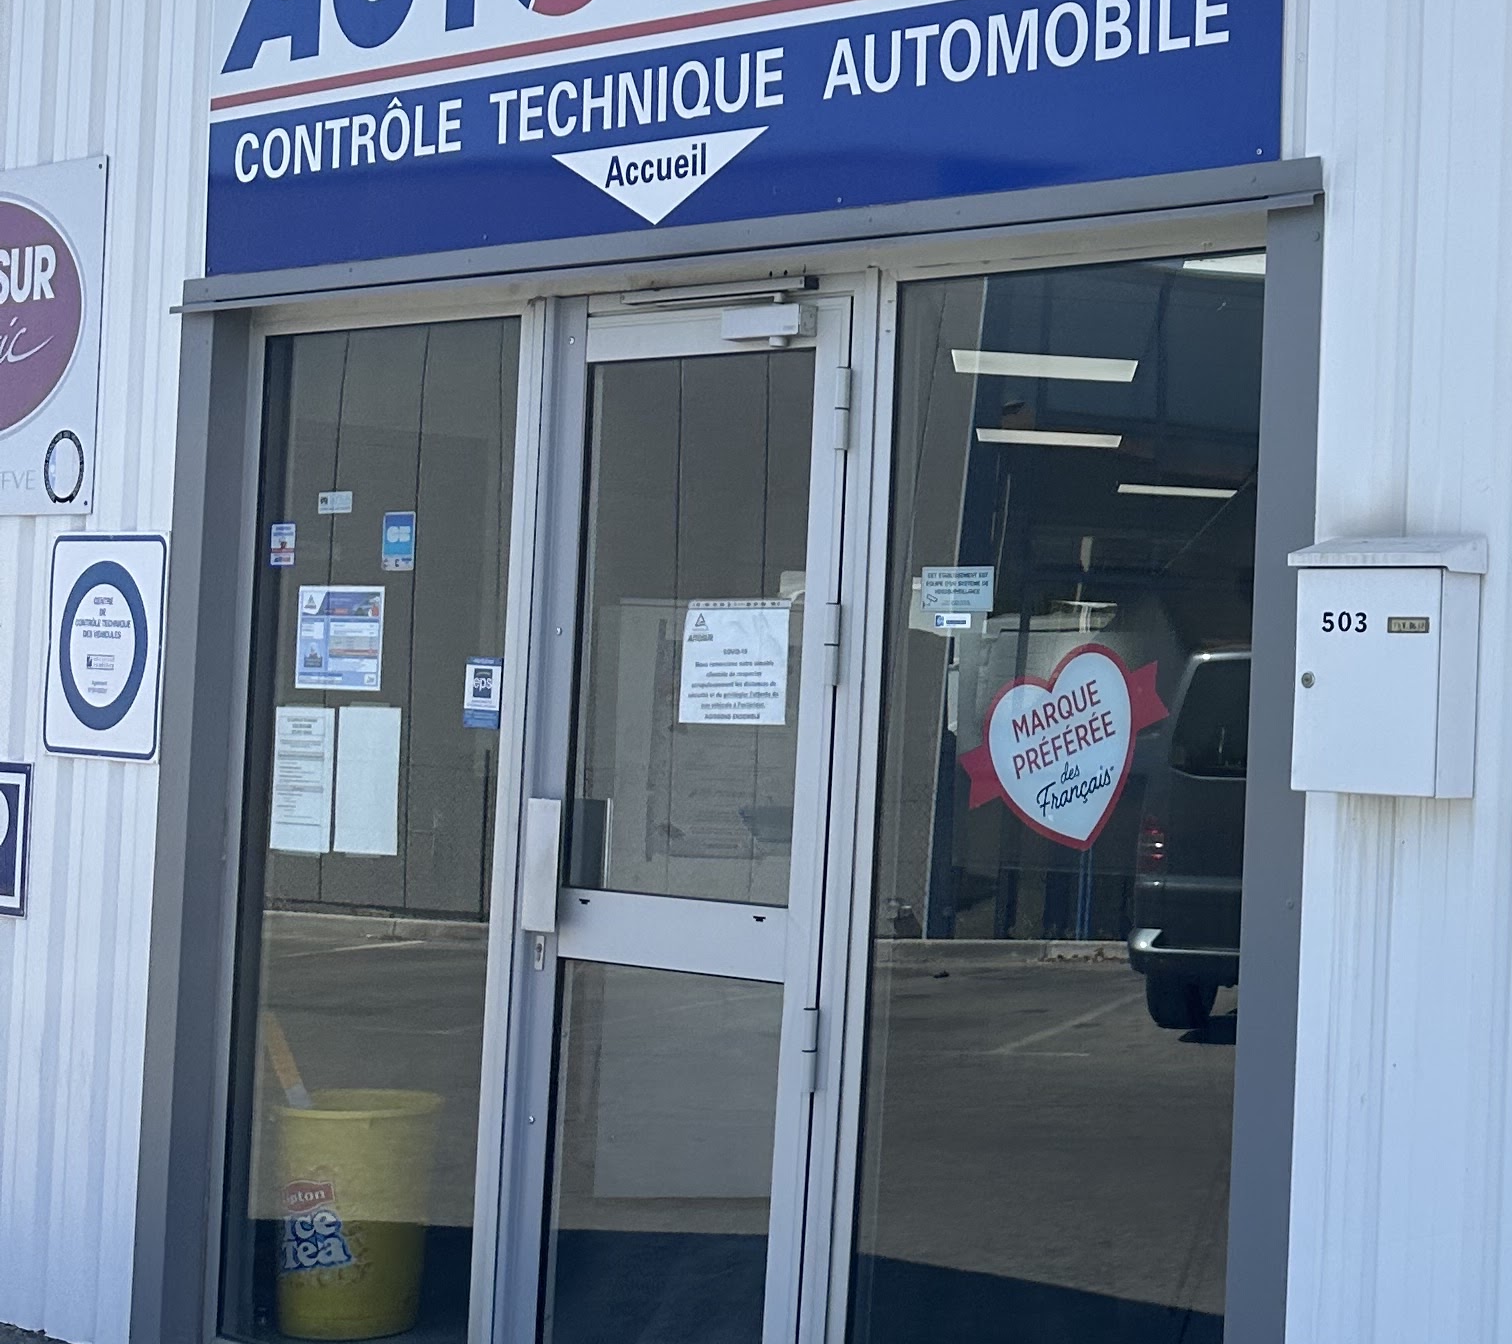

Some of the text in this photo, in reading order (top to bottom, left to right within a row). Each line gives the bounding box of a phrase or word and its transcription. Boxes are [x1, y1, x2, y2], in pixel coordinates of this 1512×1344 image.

[234, 97, 463, 183] CONTRÔLE
[489, 47, 785, 145] TECHNIQUE
[605, 143, 707, 188] Accueil
[1321, 611, 1368, 633] 503
[473, 678, 493, 692] eps
[1012, 679, 1101, 743] MARQUE
[1012, 710, 1116, 779] PRÉFÉRÉE
[1060, 761, 1080, 785] des
